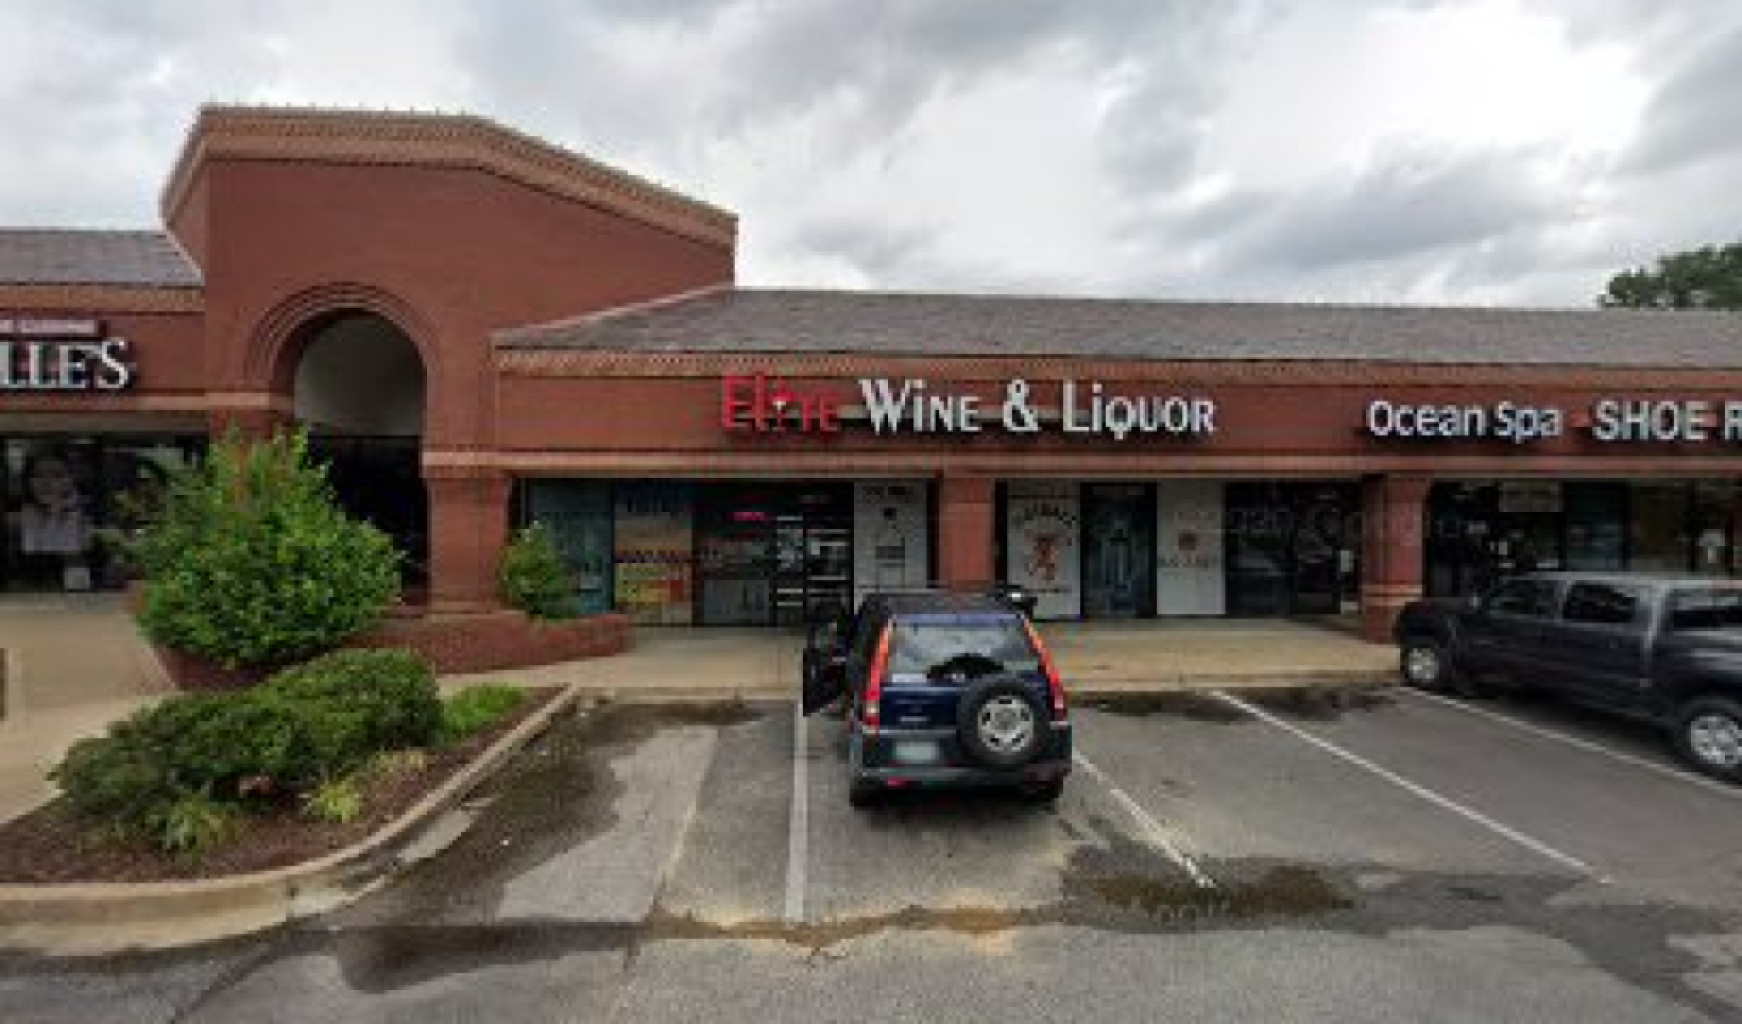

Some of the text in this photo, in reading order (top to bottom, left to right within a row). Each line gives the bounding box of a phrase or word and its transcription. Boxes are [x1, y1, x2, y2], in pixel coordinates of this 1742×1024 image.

[1003, 378, 1042, 433] &
[1368, 400, 1564, 444] Ocean Spa
[1594, 401, 1710, 440] SHOE
